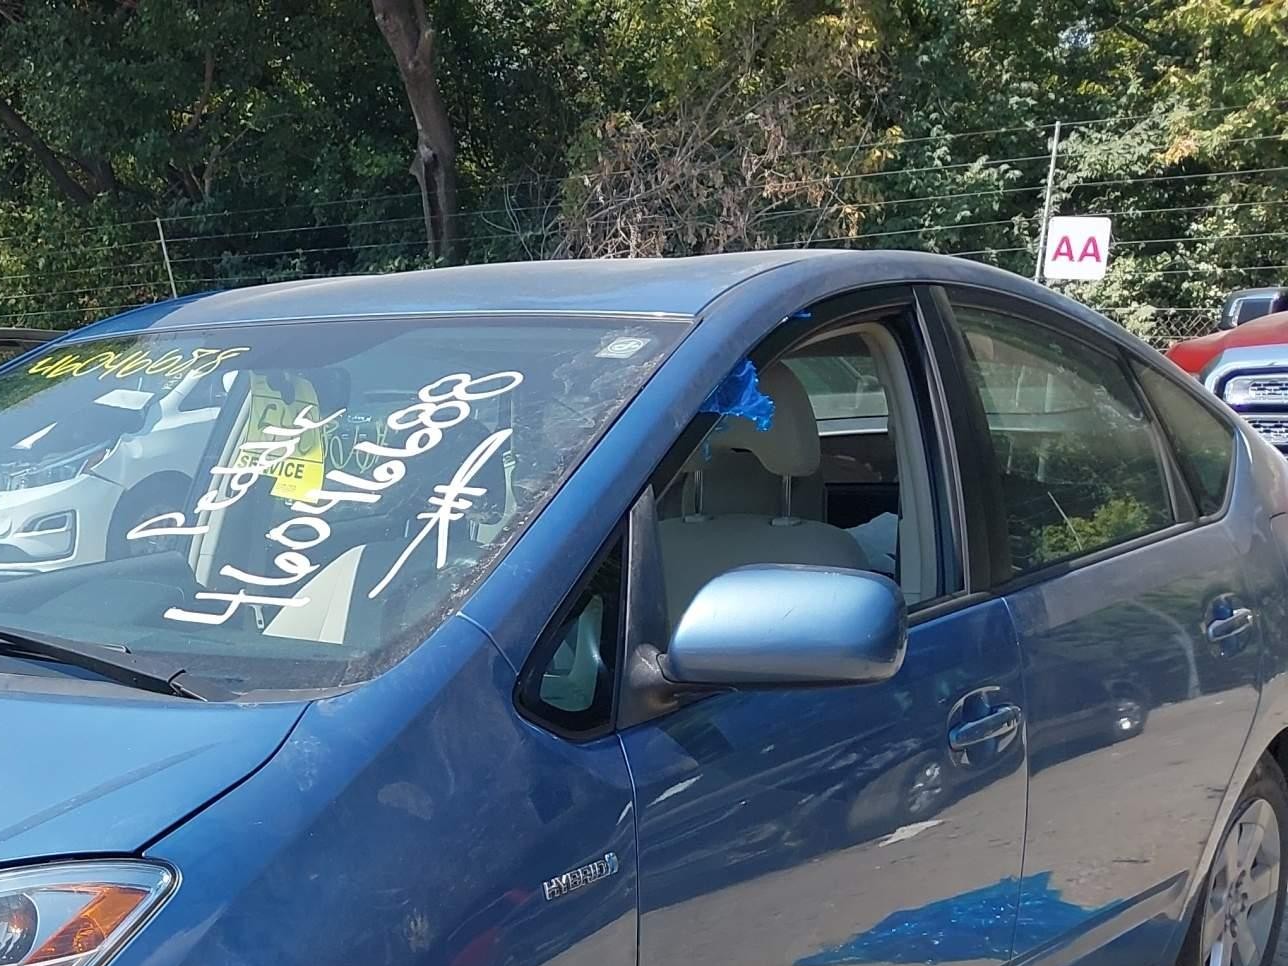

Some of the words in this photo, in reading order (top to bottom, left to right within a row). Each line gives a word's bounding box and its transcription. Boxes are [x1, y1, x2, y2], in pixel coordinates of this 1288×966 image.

[1051, 236, 1102, 262] AA
[237, 454, 305, 480] SEVICE
[163, 371, 525, 626] 46046688
[543, 860, 611, 900] HYBRID
